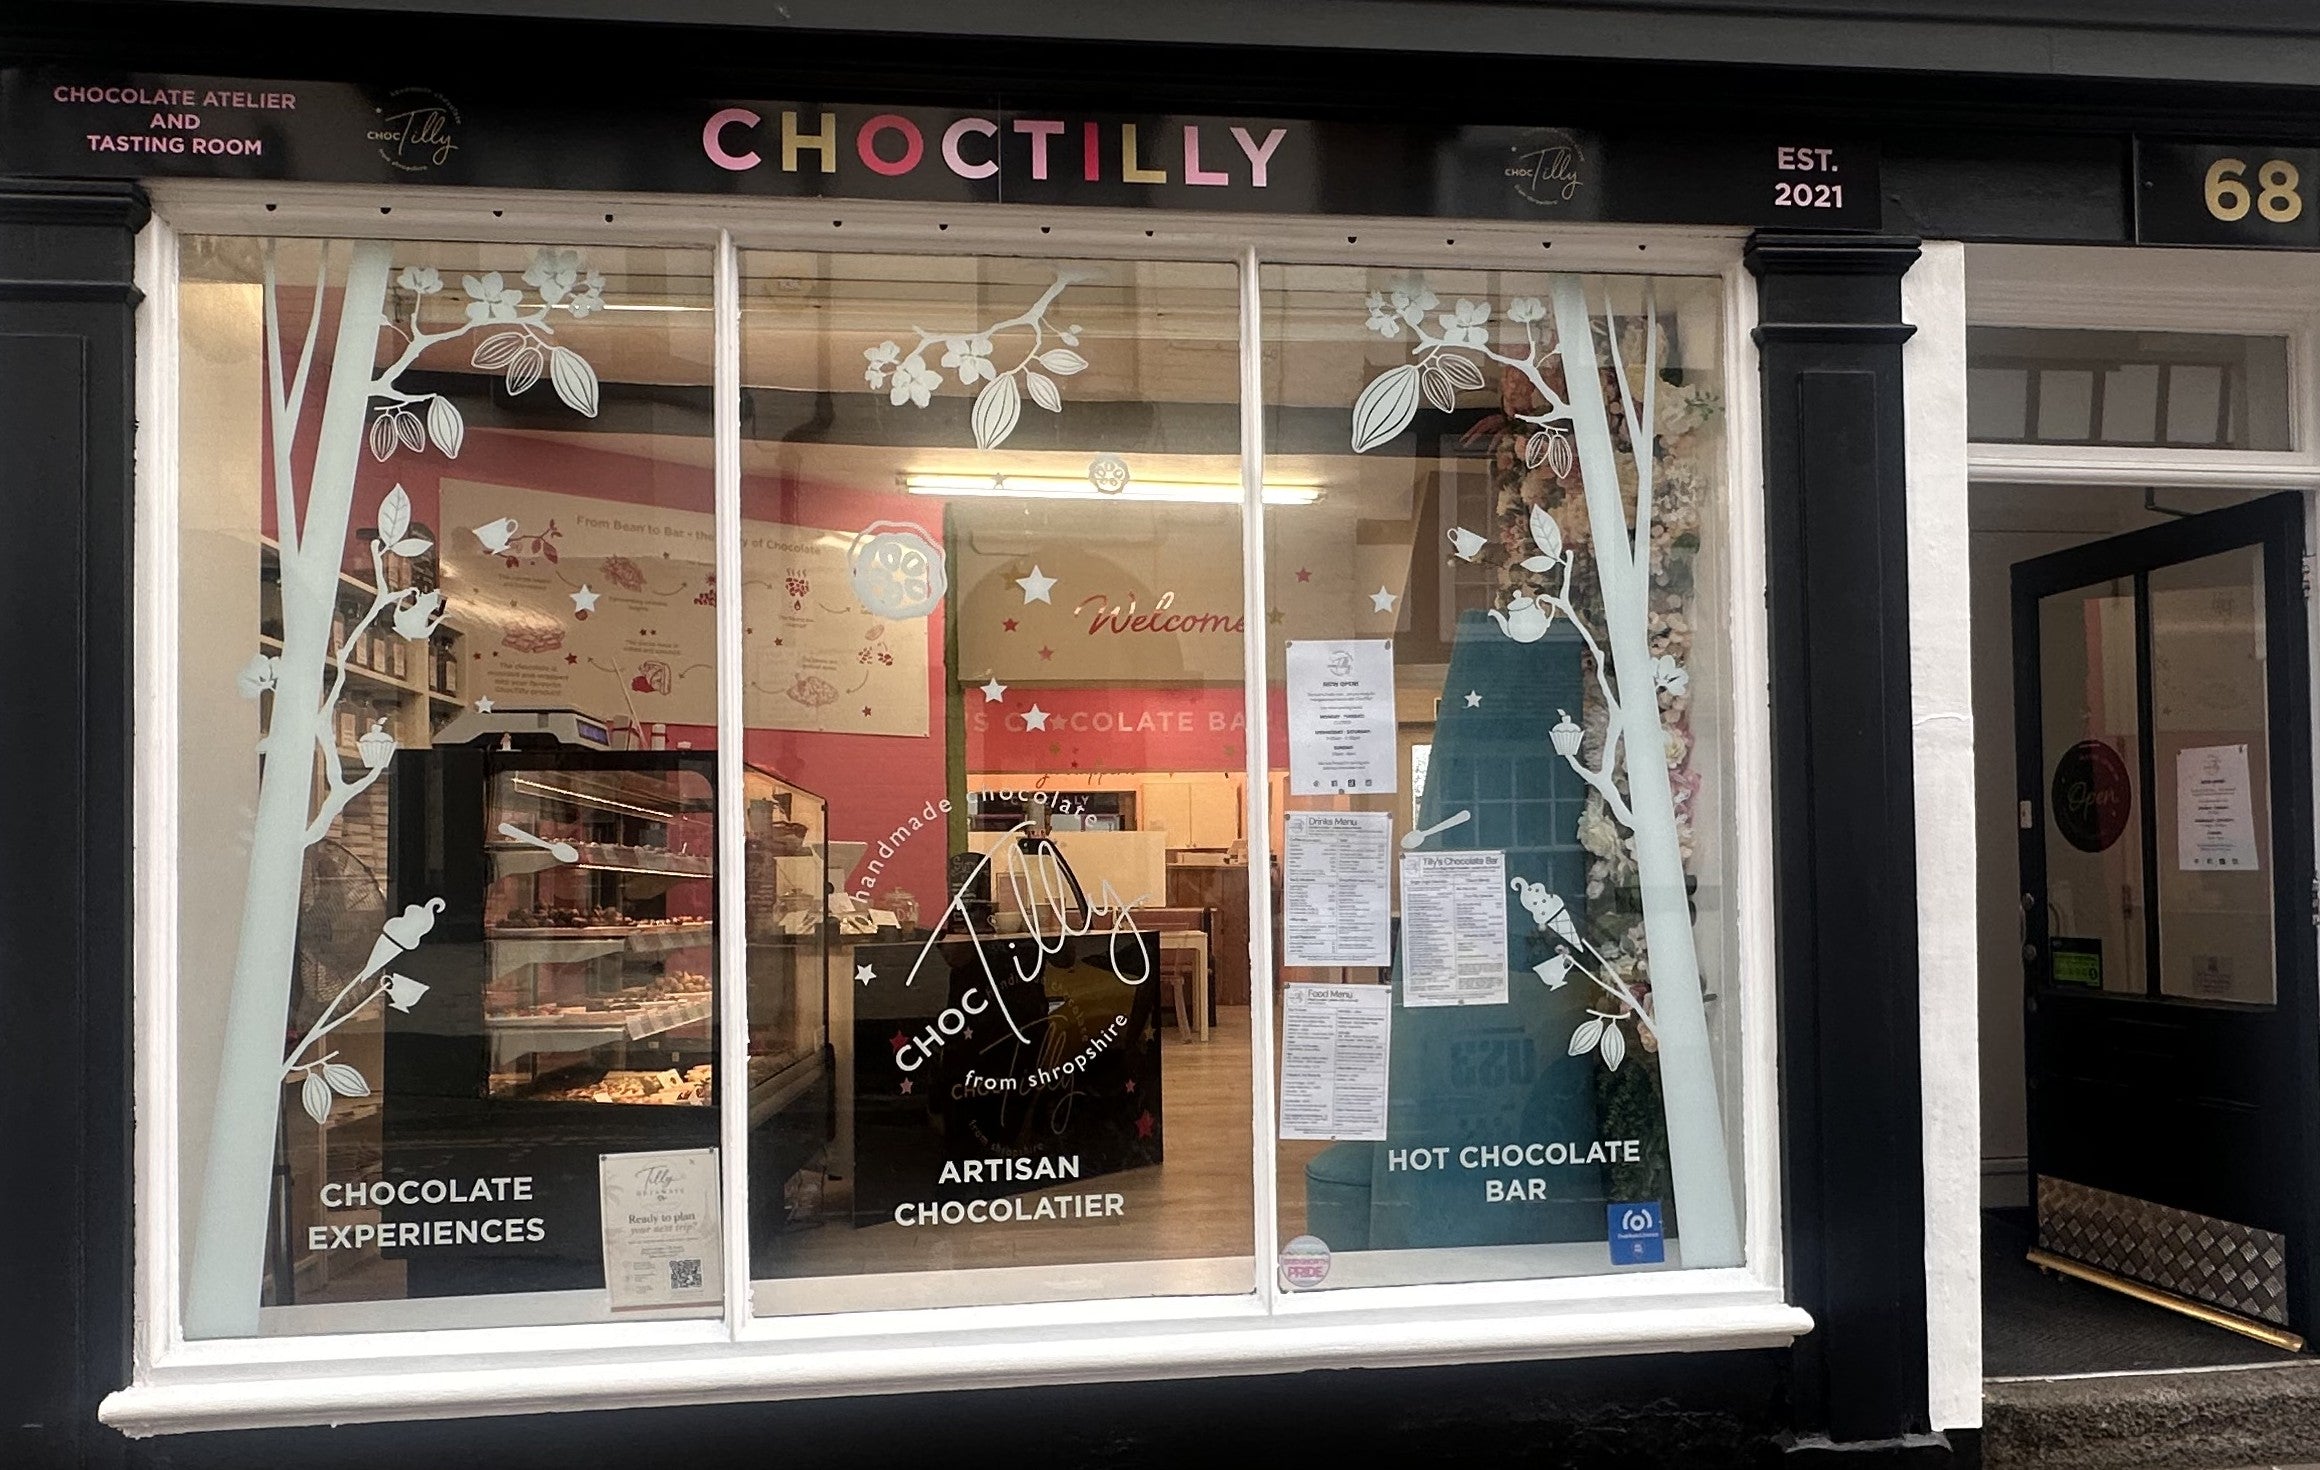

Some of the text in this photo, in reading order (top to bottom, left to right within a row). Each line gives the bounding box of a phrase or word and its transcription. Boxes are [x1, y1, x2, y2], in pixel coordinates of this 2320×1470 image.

[53, 85, 296, 110] CHOCOLATE ATELIER
[150, 113, 201, 131] AND
[87, 134, 263, 156] TASTING ROOM
[367, 131, 401, 141] CHOC
[385, 108, 459, 166] Tilly
[702, 107, 1288, 188] CHOCTILLY
[1504, 168, 1535, 178] CHOC
[1519, 146, 1584, 200] Tilly
[1777, 146, 1839, 172] EST.
[1774, 182, 1844, 209] 2021
[2203, 158, 2304, 223] 68
[576, 516, 610, 530] From
[614, 520, 644, 533] Bean
[647, 524, 660, 535] to
[664, 526, 683, 537] Bar
[752, 539, 764, 550] of
[766, 540, 822, 555] Chocolate
[1073, 591, 1245, 636] Welcome
[1308, 817, 1358, 827] Drinks Menu
[849, 796, 953, 906] handmade
[965, 783, 1098, 828] chocolate
[1443, 856, 1484, 866] Chocolate
[905, 820, 1158, 1045] Tilly
[1307, 989, 1353, 999] Food Menu
[894, 987, 990, 1073] CHOC
[965, 1012, 1129, 1092] from shropshire
[938, 1155, 1080, 1184] ARTISAN
[1388, 1140, 1641, 1172] HOT CHOCOLATE
[319, 1176, 534, 1208] CHOCOLATE
[1485, 1178, 1547, 1202] BAR
[628, 1211, 696, 1226] Ready to plan
[894, 1193, 1125, 1227] CHOCOLATIER
[308, 1217, 546, 1250] EXPERIENCES
[1287, 1266, 1323, 1278] PRIDE
